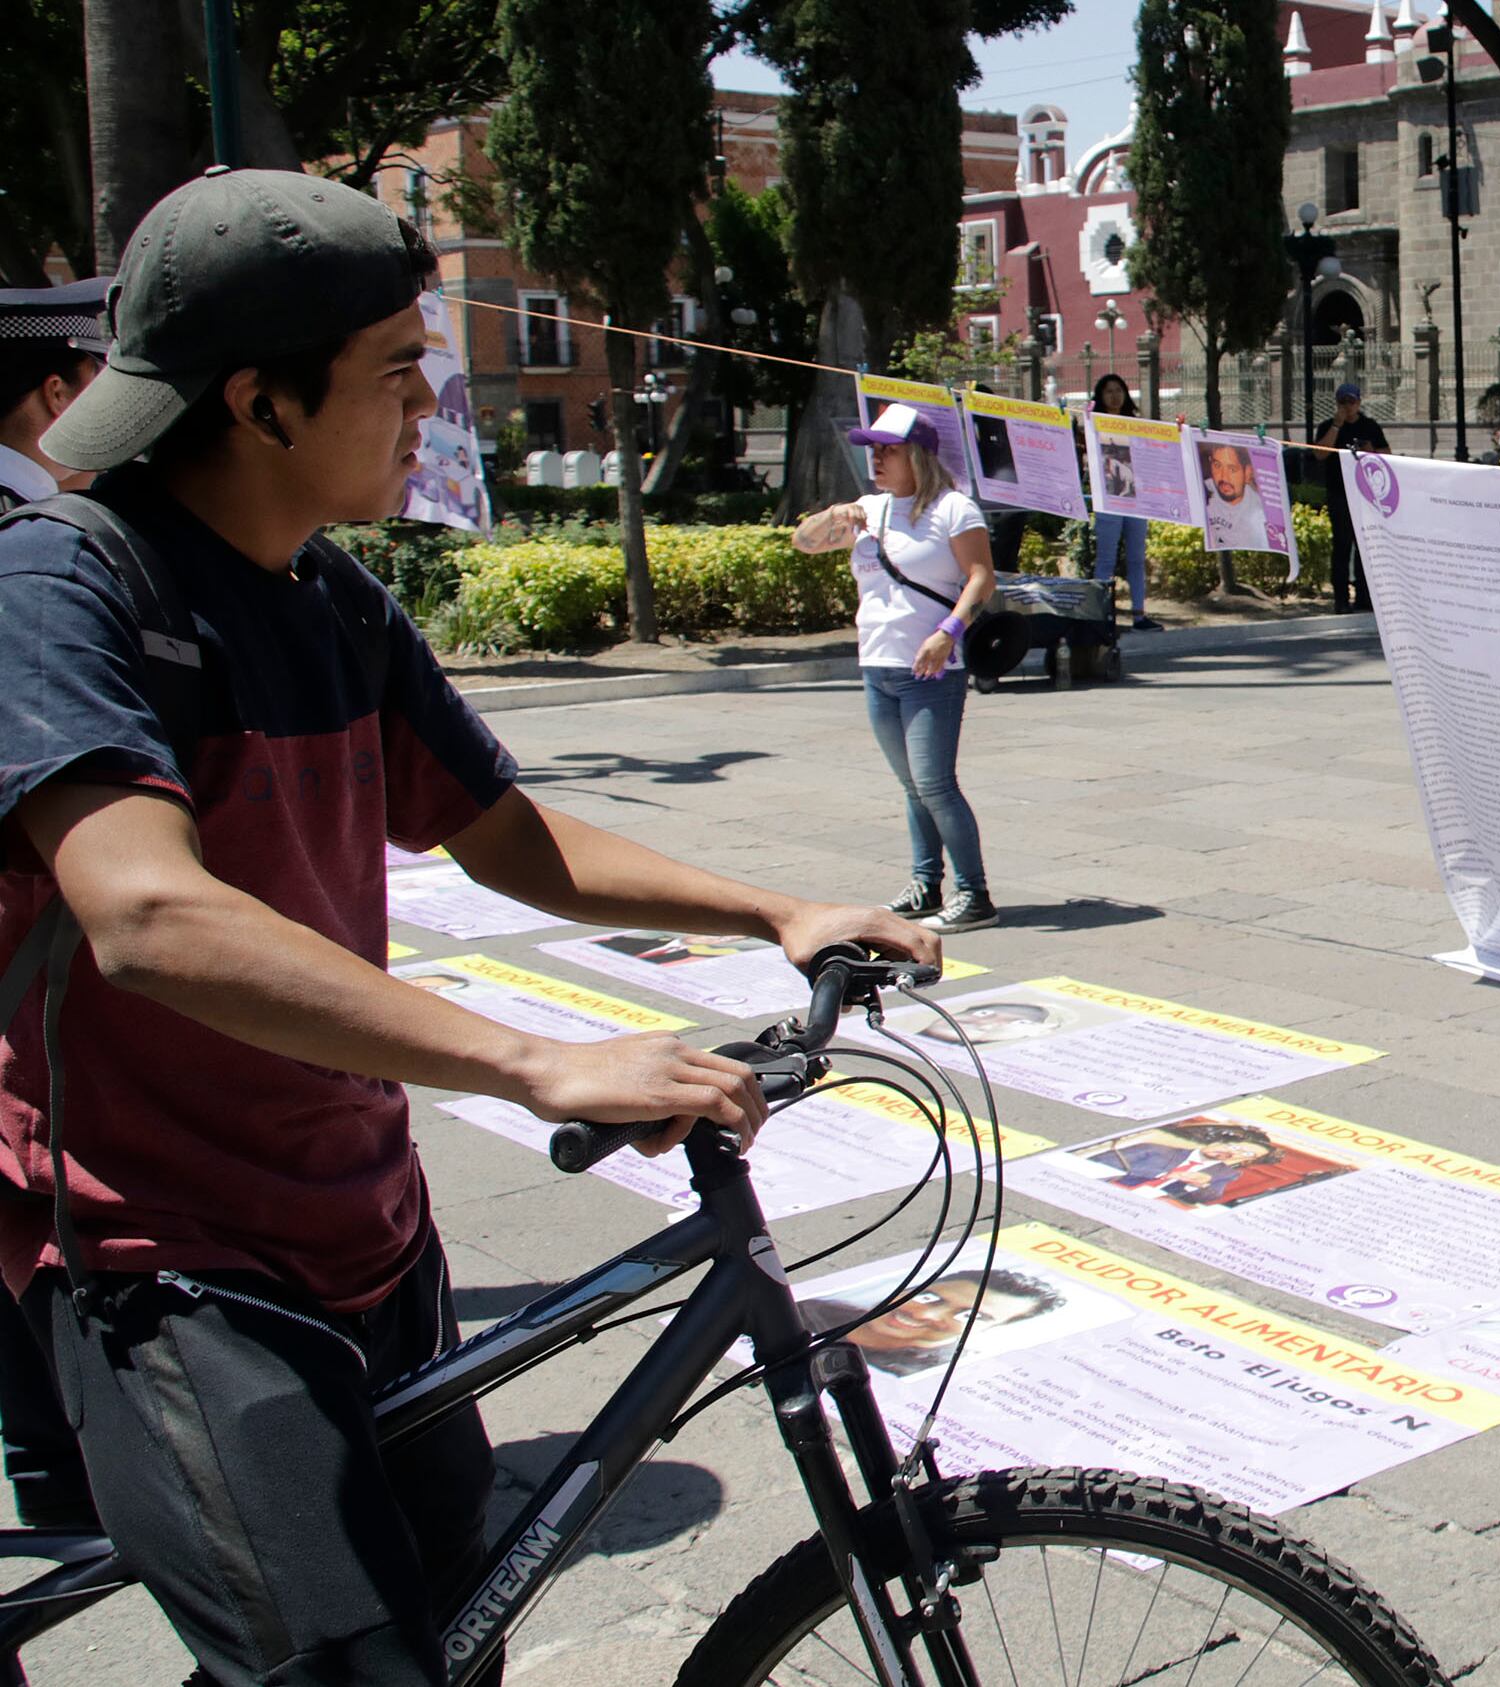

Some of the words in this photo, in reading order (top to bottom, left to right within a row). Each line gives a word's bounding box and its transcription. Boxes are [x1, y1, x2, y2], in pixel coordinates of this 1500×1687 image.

[1056, 982, 1165, 1016] DEUDOR
[1168, 1008, 1345, 1055] ALIMENTARIO
[1266, 1110, 1408, 1154] DEUDOR
[1029, 1241, 1186, 1305] DEUDOR
[1193, 1303, 1463, 1404] ALIMENTARIO
[1155, 1328, 1226, 1361] Beto
[1389, 1414, 1432, 1433] N
[442, 1517, 562, 1662] ORTEAM
